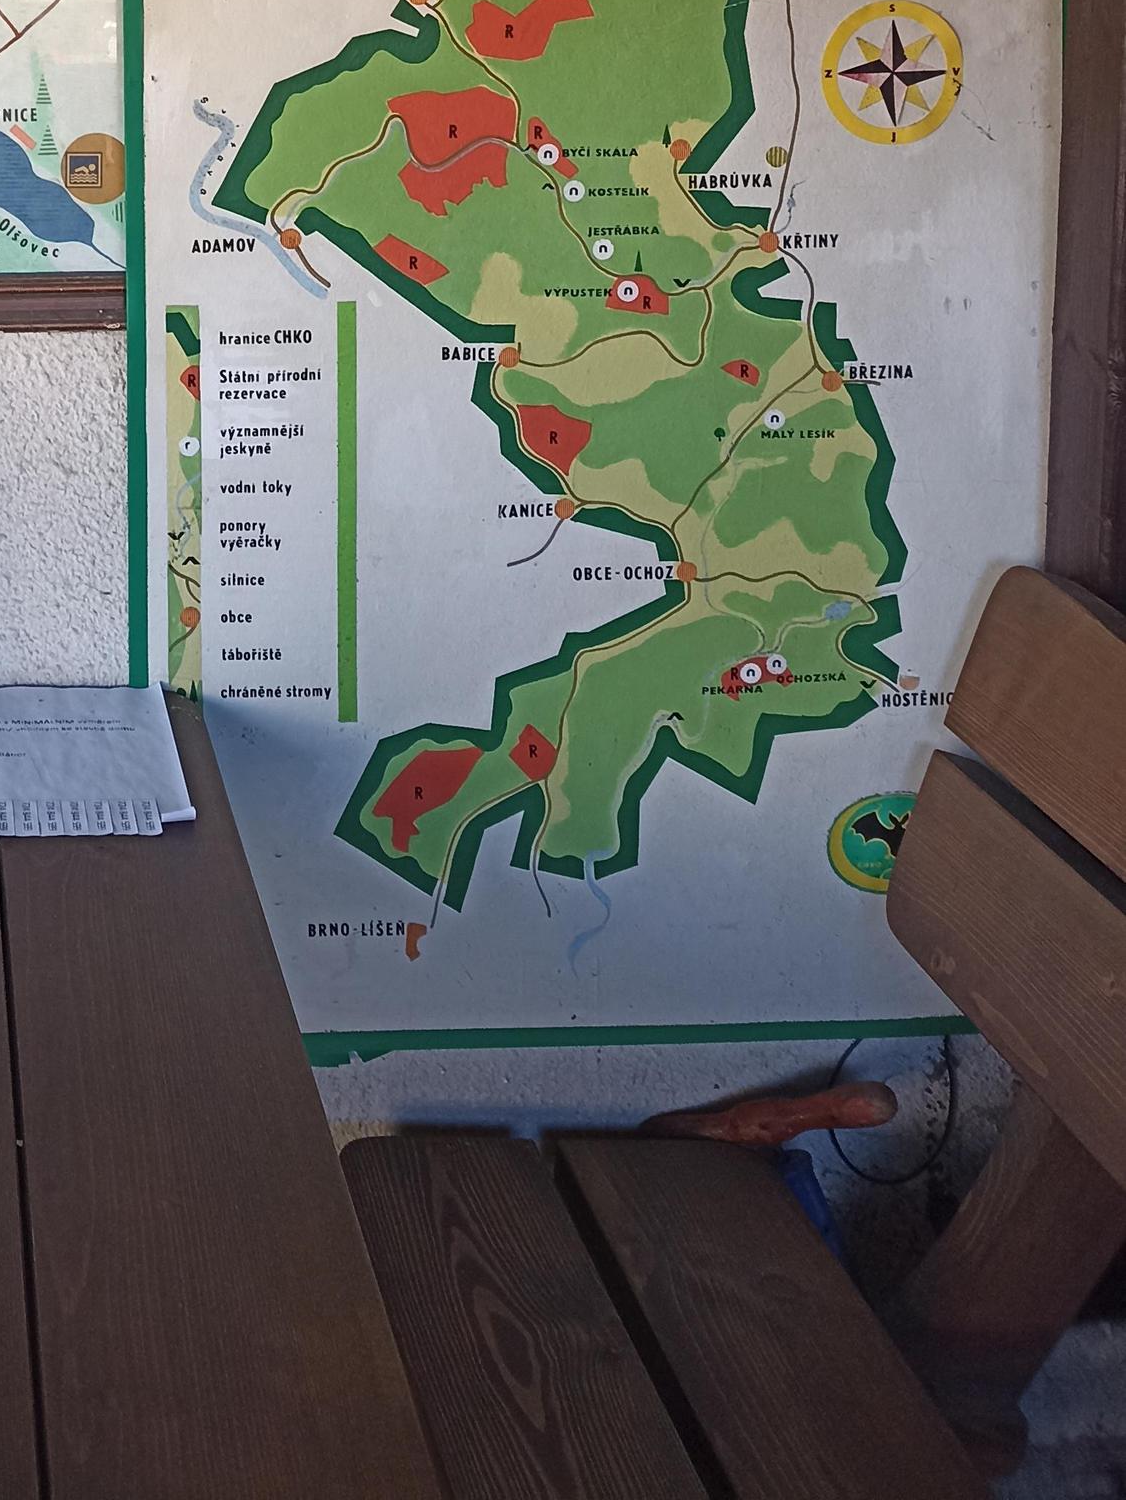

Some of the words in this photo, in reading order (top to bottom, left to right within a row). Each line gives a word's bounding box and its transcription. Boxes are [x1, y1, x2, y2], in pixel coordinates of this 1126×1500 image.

[888, 3, 896, 13] S
[505, 24, 514, 39] R
[824, 69, 833, 78] Z
[449, 124, 458, 139] R
[534, 126, 543, 140] R
[688, 172, 772, 190] HABRŮVKA
[588, 225, 660, 237] JESTŘÁBKA
[192, 238, 255, 254] ADAMOV
[783, 233, 839, 249] KŘTINY
[409, 256, 419, 270] R
[544, 286, 612, 298] VÝPUSTEK
[642, 296, 651, 310] R
[219, 332, 271, 345] hranice
[274, 330, 312, 344] CHKO
[441, 346, 496, 362] BABICE
[219, 369, 260, 384] Státní
[267, 368, 321, 385] přírodní
[740, 364, 749, 378] R
[849, 363, 914, 380] BŘEZINA
[187, 374, 196, 387] R
[219, 389, 287, 400] rezervace
[220, 424, 304, 440] významnější
[549, 430, 558, 444] R
[761, 428, 794, 439] MALÝ
[220, 442, 272, 459] jeskyně
[262, 480, 292, 496] toky
[498, 503, 554, 519] KANICE
[220, 522, 266, 535] ponory
[220, 573, 265, 587] silnice
[220, 610, 253, 623] obce
[222, 648, 282, 661] tábořiště
[730, 668, 739, 681] R
[776, 671, 847, 684] OCHOZSKÁ
[220, 685, 282, 698] chráněné
[286, 685, 332, 700] stromy
[529, 745, 538, 759] R
[414, 786, 423, 800] R
